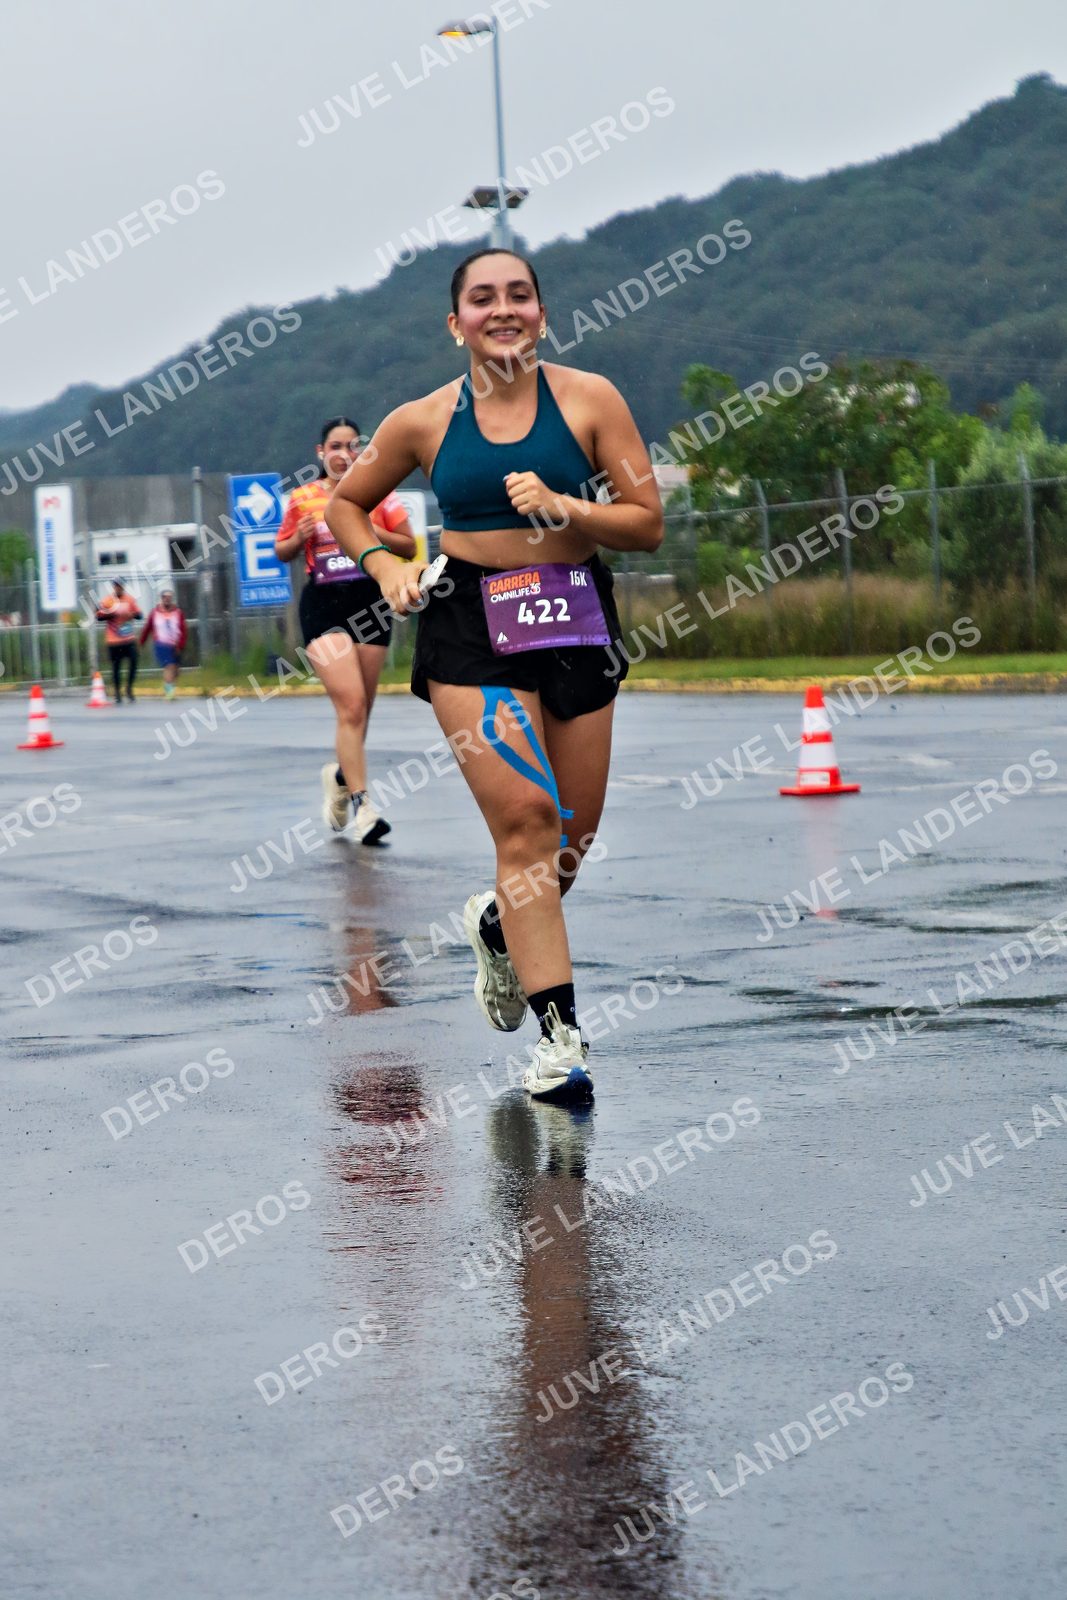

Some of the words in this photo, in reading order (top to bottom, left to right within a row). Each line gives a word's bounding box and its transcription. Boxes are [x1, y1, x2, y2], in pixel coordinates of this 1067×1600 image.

[243, 531, 281, 578] E
[489, 571, 540, 594] CARRERA
[569, 570, 588, 587] 15K
[490, 587, 531, 603] OMNILIFE
[517, 597, 571, 625] 422
